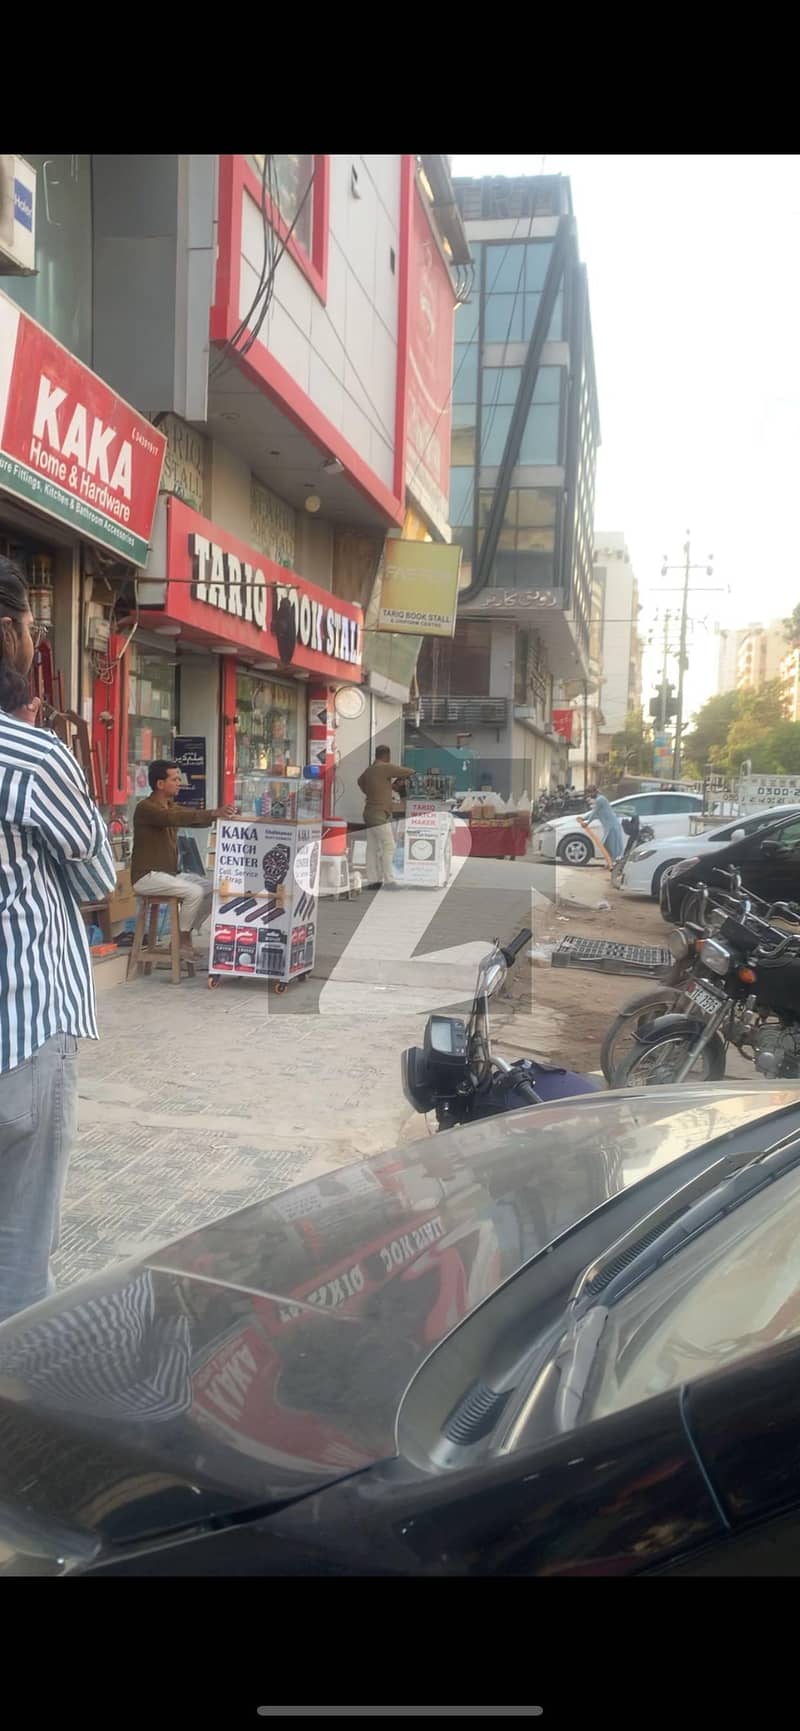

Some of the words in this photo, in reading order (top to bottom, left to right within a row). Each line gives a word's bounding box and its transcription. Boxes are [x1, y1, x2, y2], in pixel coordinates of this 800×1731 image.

[32, 373, 132, 500] KAKA
[29, 437, 66, 481] Home
[69, 466, 79, 489] &
[80, 471, 131, 522] Hardware
[44, 482, 69, 507] Kitchen
[69, 498, 75, 510] &
[75, 502, 104, 527] Bathroom
[104, 520, 135, 547] Accessories
[190, 533, 267, 632] TARIQ
[326, 608, 362, 666] STALL
[384, 609, 404, 618] TARIQ
[405, 611, 428, 621] BOOK
[428, 614, 449, 624] STALL
[221, 843, 257, 854] WATCH
[222, 826, 258, 840] KAKA
[220, 856, 258, 868] CENTER
